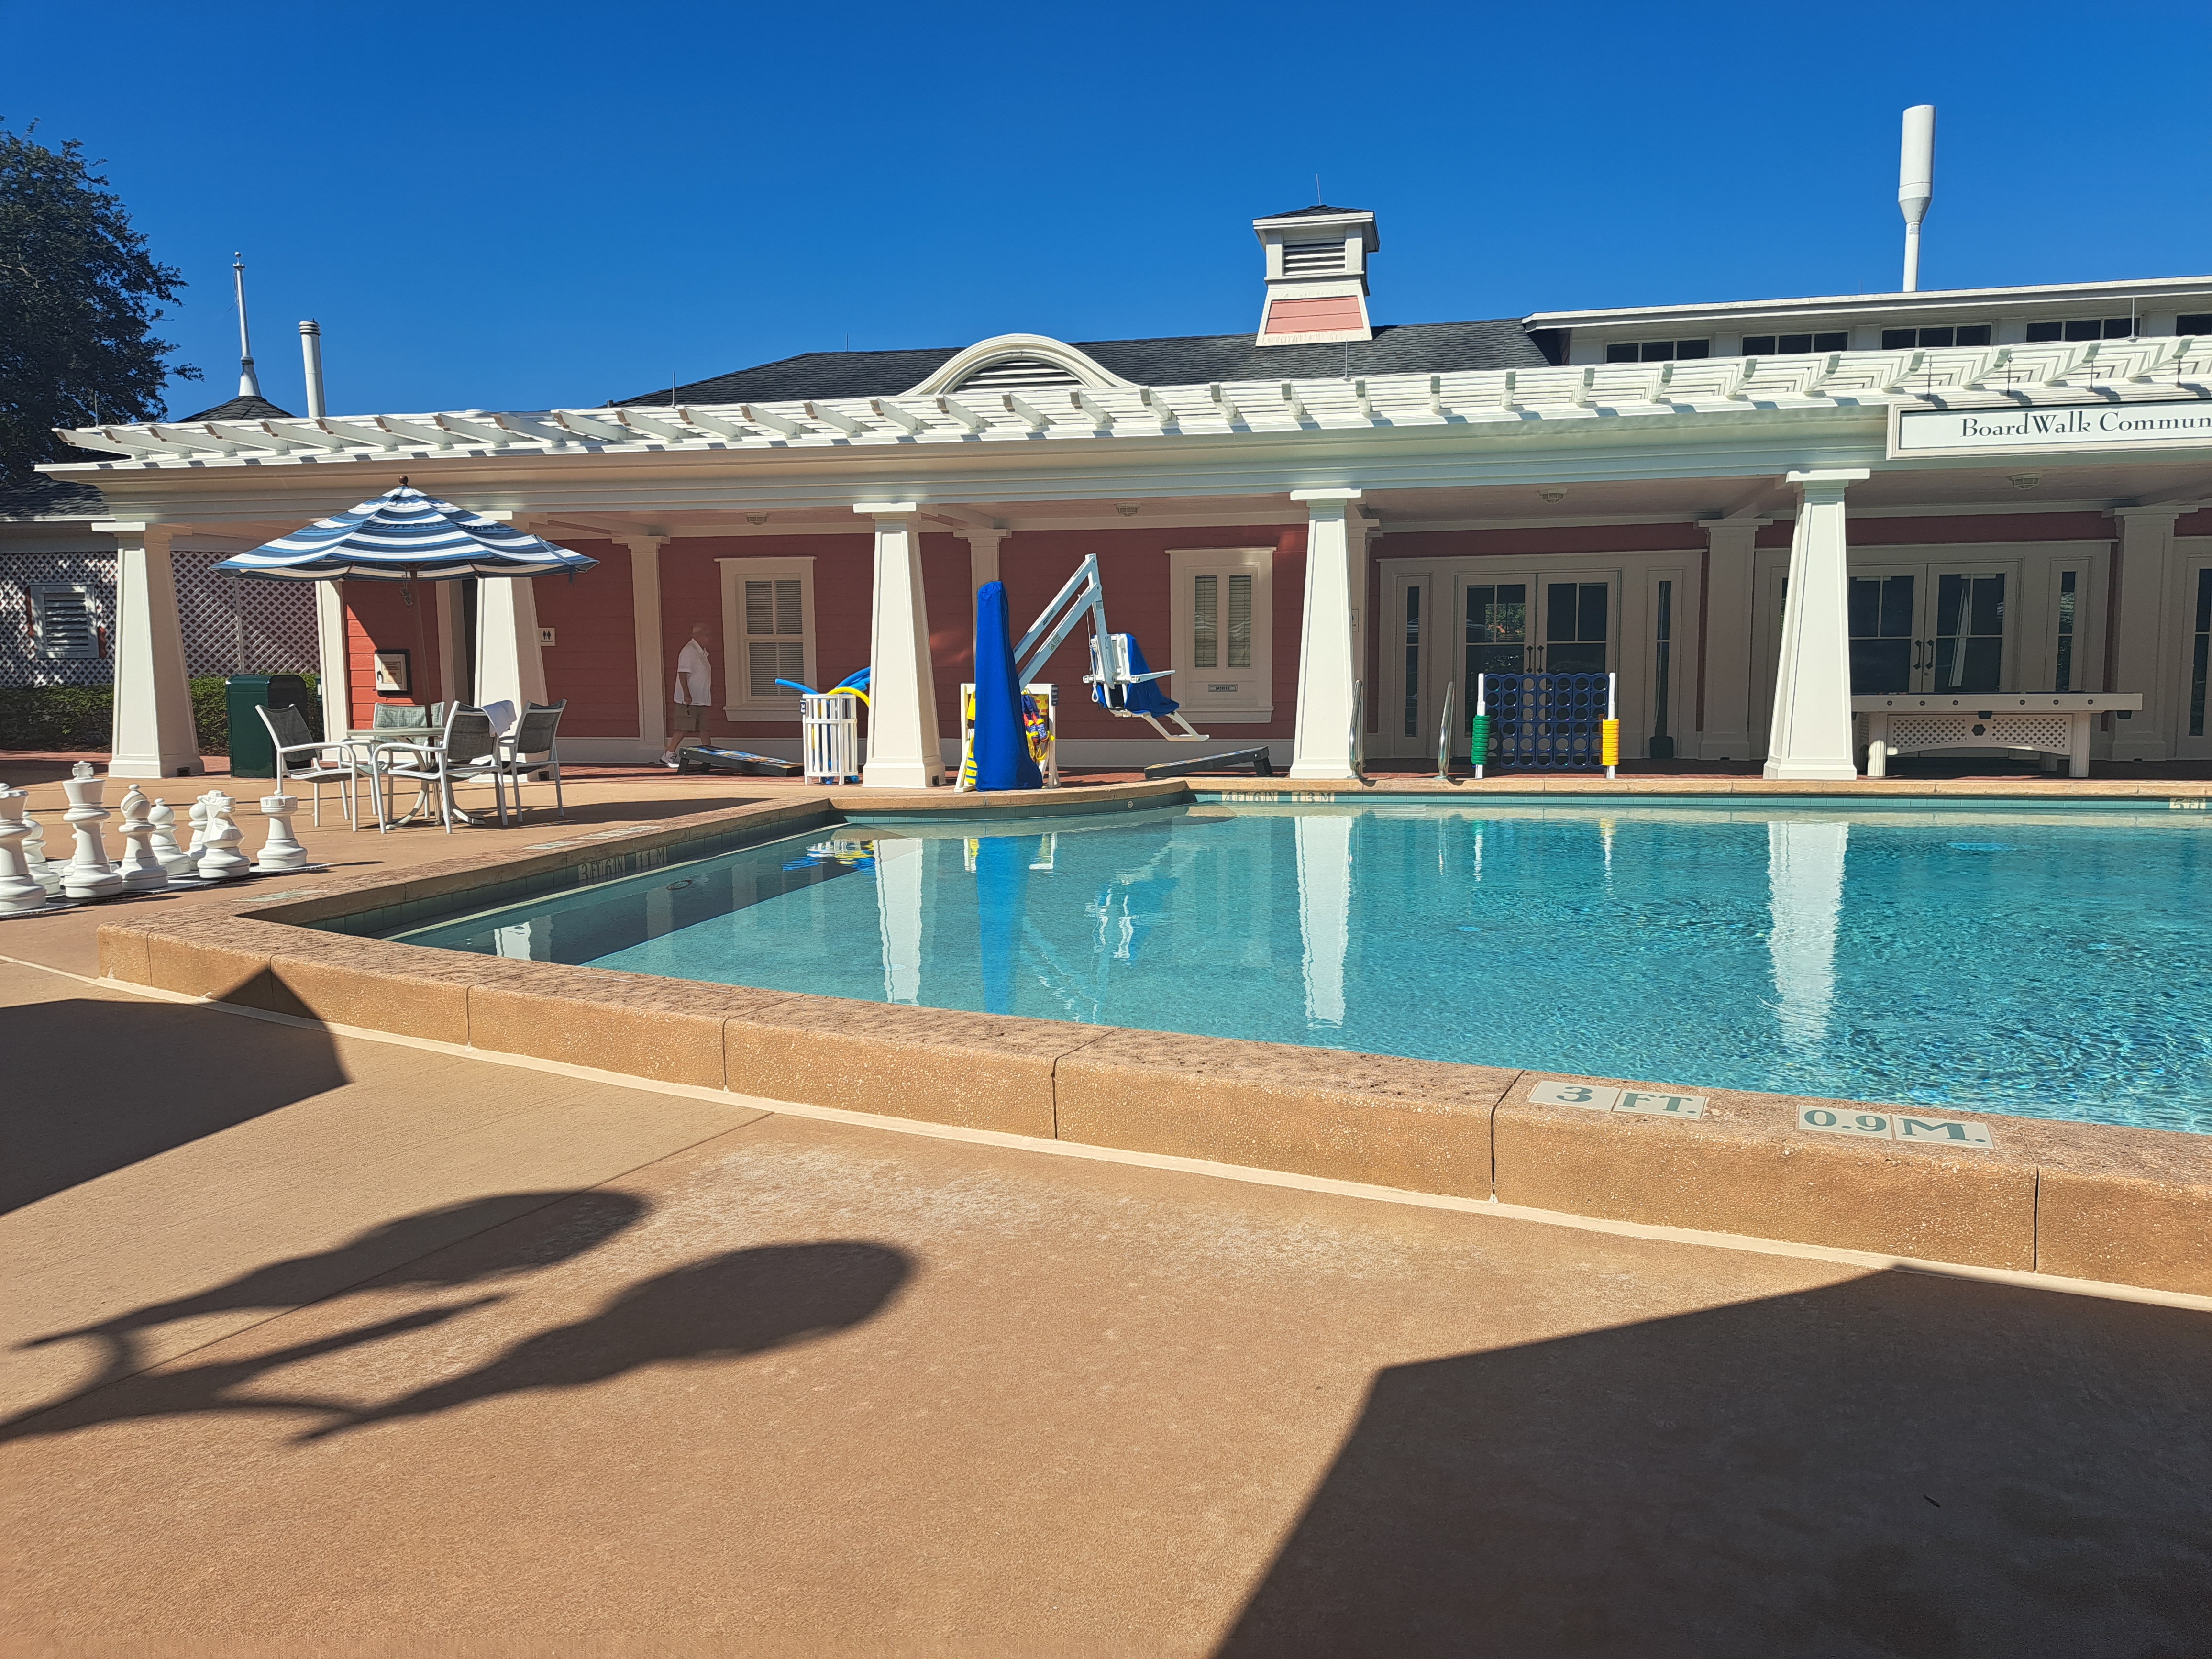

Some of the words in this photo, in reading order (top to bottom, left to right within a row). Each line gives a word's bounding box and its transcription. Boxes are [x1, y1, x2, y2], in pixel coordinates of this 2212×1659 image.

[1959, 410, 2091, 437] BoardWalk
[1224, 792, 1233, 803] 4
[1236, 792, 1248, 802] FT
[1252, 791, 1261, 803] 6
[1264, 791, 1275, 803] IN
[2174, 798, 2184, 809] 5
[2189, 798, 2204, 809] FT
[581, 864, 589, 880] 3
[589, 861, 601, 879] FT
[605, 859, 612, 875] 6
[614, 856, 623, 873] IN
[1556, 1086, 1593, 1102] 3
[1619, 1092, 1697, 1114] FT.
[1804, 1109, 1887, 1132] 0.9
[1898, 1117, 1986, 1143] M.
